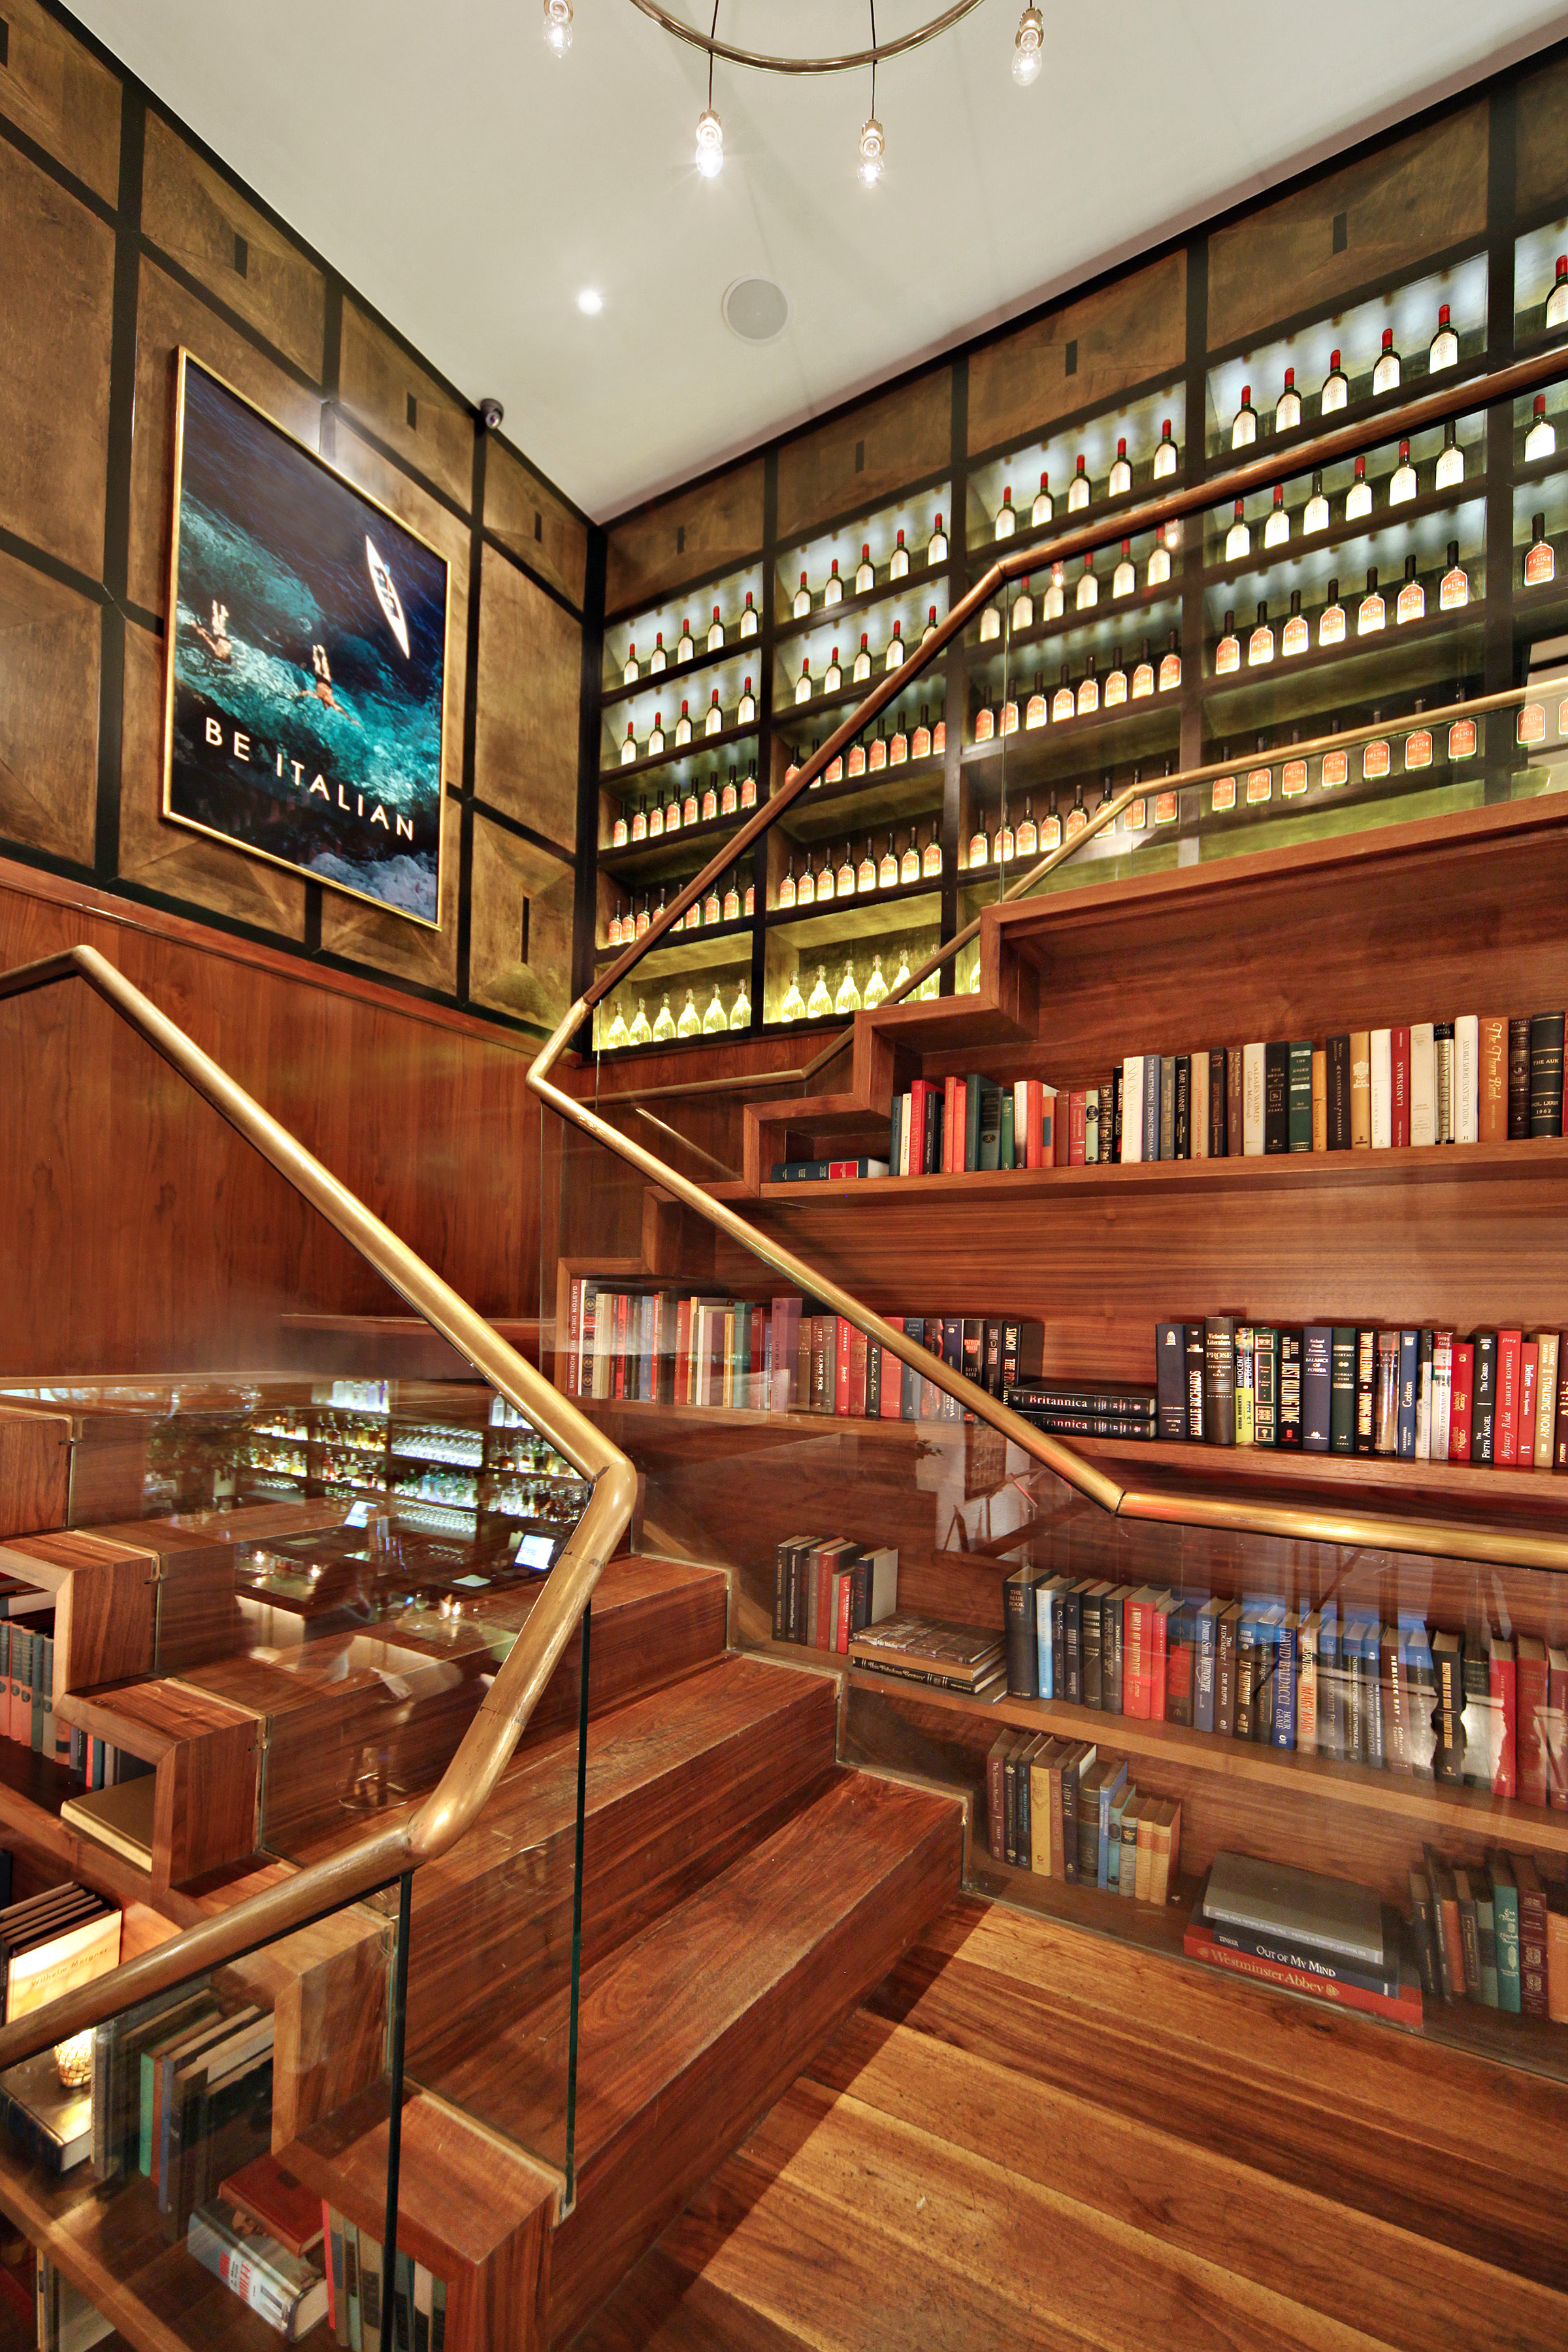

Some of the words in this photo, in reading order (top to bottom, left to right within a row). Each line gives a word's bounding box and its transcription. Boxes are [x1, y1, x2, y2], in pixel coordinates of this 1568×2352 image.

[206, 717, 250, 762] BE
[276, 753, 414, 841] ITALIAN
[1486, 1022, 1502, 1043] The
[1441, 1043, 1449, 1081] RIDING
[1486, 1046, 1502, 1075] Thorn
[1441, 1085, 1449, 1104] THE
[1488, 1077, 1501, 1100] Birds
[1441, 1110, 1449, 1136] BULL
[1005, 1328, 1017, 1350] SIMON
[1360, 1332, 1373, 1348] TONY
[1281, 1362, 1299, 1379] JUST
[1360, 1348, 1373, 1382] HILLERMAN
[1480, 1363, 1488, 1380] GREEN
[1524, 1364, 1534, 1386] Before
[1190, 1370, 1201, 1407] RICHARDS
[1281, 1379, 1299, 1405] KILLING
[1402, 1382, 1413, 1408] Cotton
[1541, 1377, 1552, 1410] STALKING
[1029, 1394, 1088, 1408] Britannica
[1359, 1393, 1372, 1416] FINDING
[1190, 1408, 1201, 1436] EMILIE
[1281, 1406, 1299, 1423] TIME
[1358, 1416, 1371, 1435] MOON
[1501, 1412, 1511, 1428] Ride
[1540, 1414, 1551, 1438] IVORY
[1482, 1415, 1491, 1438] ANGEL
[1458, 1429, 1466, 1452] Night
[1481, 1440, 1490, 1458] FIFTH
[1501, 1431, 1514, 1459] Mystery
[1130, 1612, 1141, 1631] WORLD
[1202, 1620, 1212, 1641] DANIELLE
[1104, 1618, 1114, 1656] PERFECT
[1130, 1632, 1141, 1641] OF
[1279, 1631, 1292, 1659] DAVID
[1303, 1636, 1313, 1654] JAMES
[1128, 1642, 1141, 1677] DIFFERENCE
[1201, 1641, 1212, 1656] STEEL
[1260, 1637, 1269, 1661] gotham
[1104, 1658, 1113, 1676] SPY
[1196, 1657, 1213, 1693] KALEIDOSCOPE
[1239, 1659, 1251, 1669] IT
[1259, 1663, 1268, 1680] tragic
[1302, 1654, 1313, 1683] PATTERSON
[1238, 1670, 1250, 1706] ROUGHING
[1260, 1686, 1269, 1698] kurt
[1278, 1660, 1291, 1705] BALDACCI
[1301, 1686, 1314, 1710] MARY
[1259, 1700, 1267, 1723] wenzel
[1444, 1713, 1452, 1733] ELIZABETH
[1301, 1711, 1314, 1736] MARY
[1327, 1714, 1335, 1737] POWER
[1444, 1733, 1453, 1749] GEORGE
[1218, 1936, 1239, 1947] TINKER
[31, 1967, 67, 1987] Wilhelm
[71, 1949, 108, 1968] Morgner
[1210, 1948, 1284, 1981] Westminster
[1284, 1972, 1324, 1993] Abbey
[1256, 1945, 1277, 1959] OUT
[1277, 1953, 1288, 1963] OF
[1290, 1955, 1306, 1969] MY
[1308, 1960, 1337, 1978] MIND
